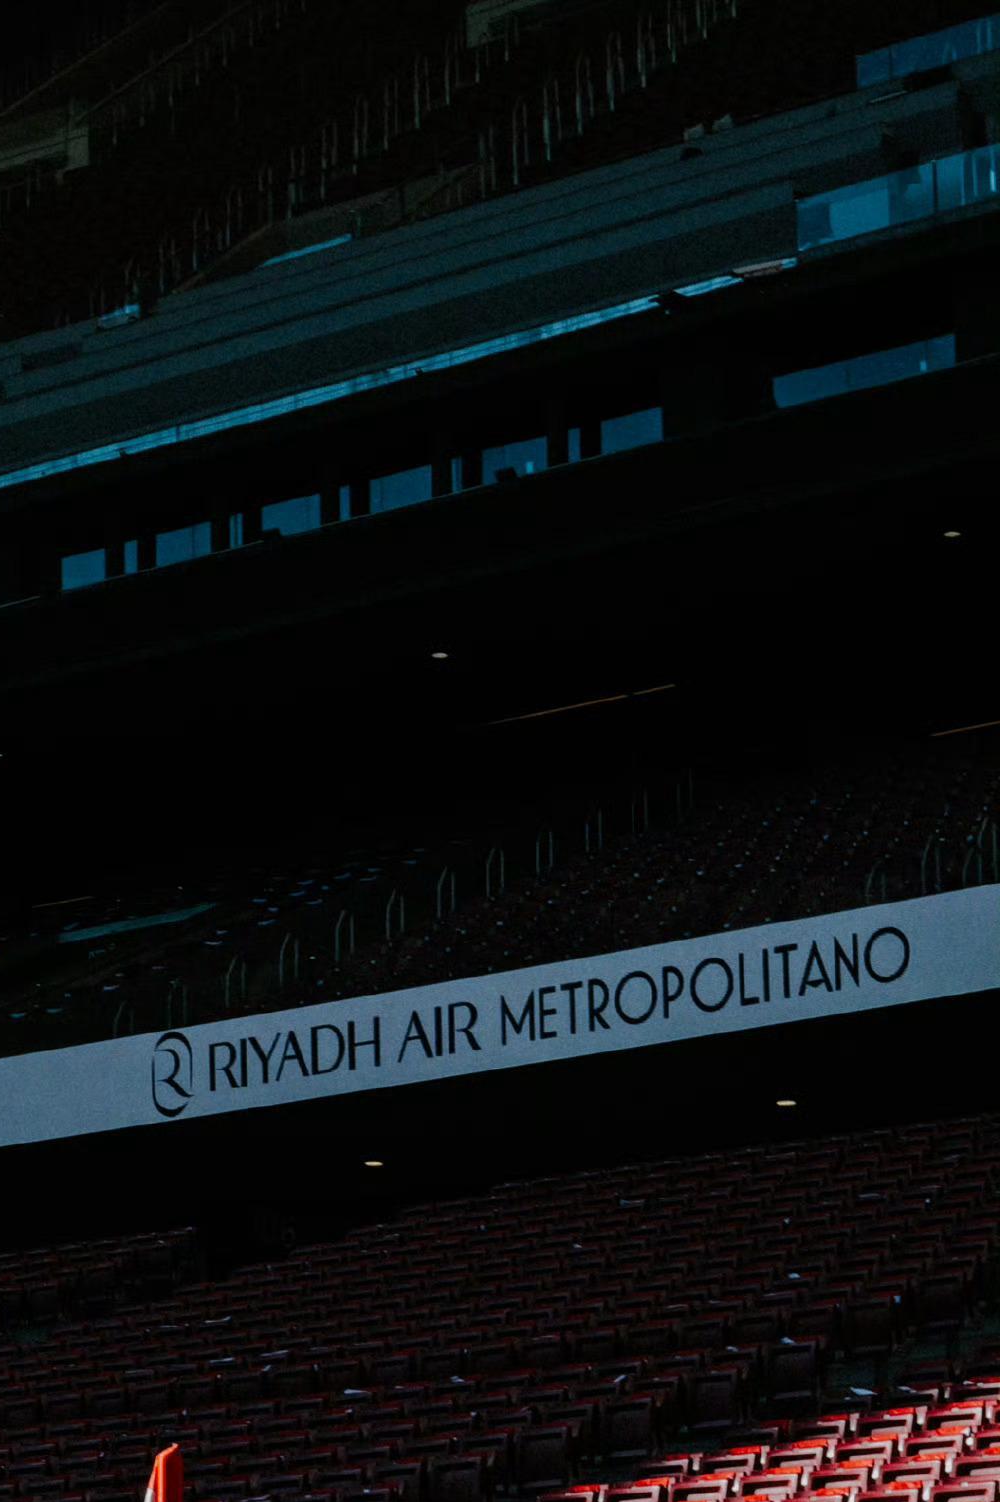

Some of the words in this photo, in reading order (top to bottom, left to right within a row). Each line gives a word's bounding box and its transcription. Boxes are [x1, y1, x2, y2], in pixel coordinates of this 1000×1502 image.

[208, 1016, 381, 1091] RIYADH
[398, 1001, 482, 1063] AIR
[500, 926, 911, 1046] METROPOLITANO
